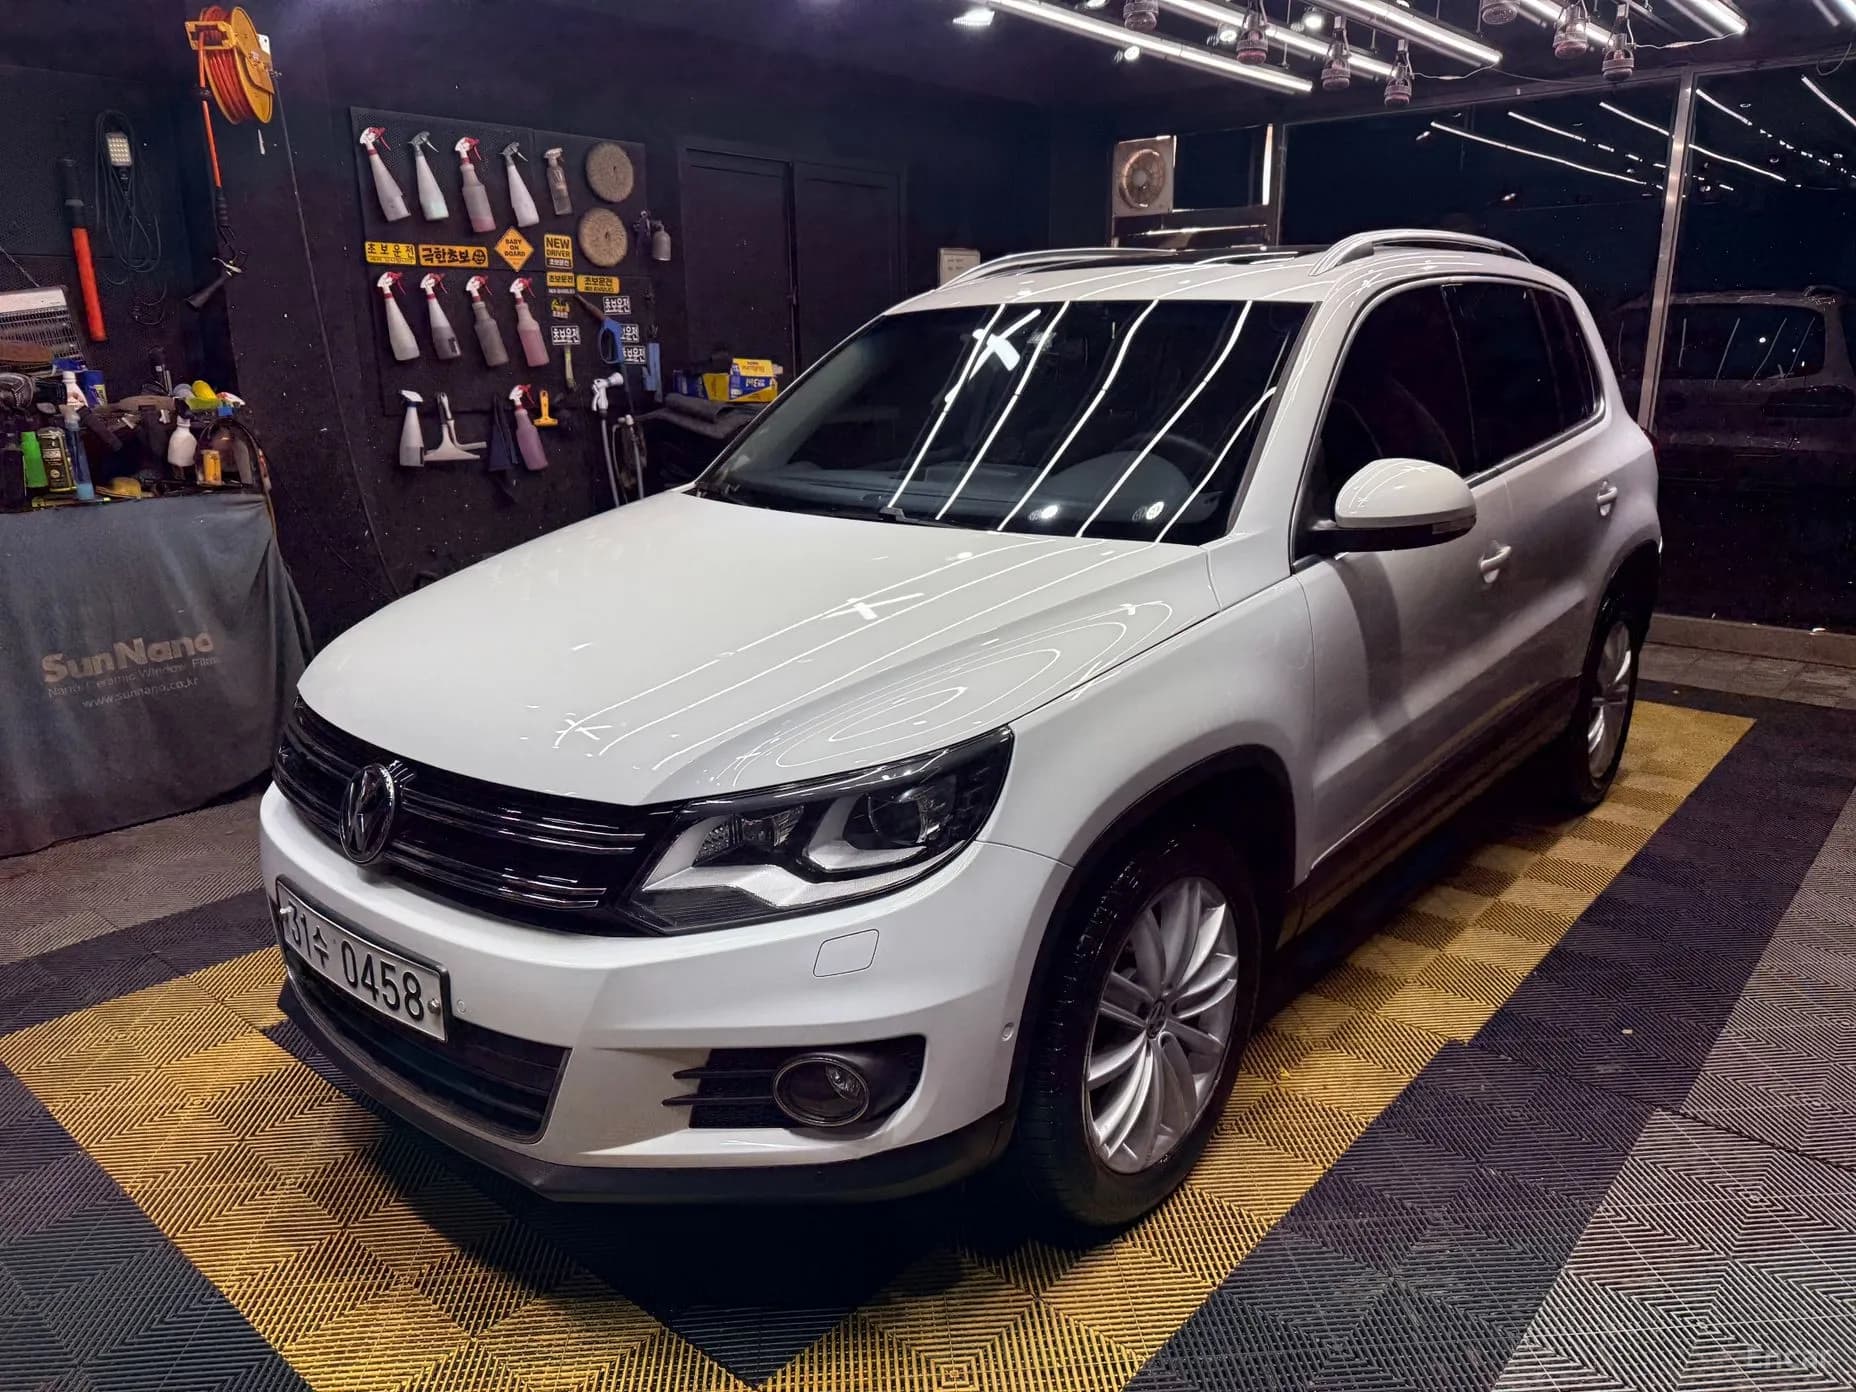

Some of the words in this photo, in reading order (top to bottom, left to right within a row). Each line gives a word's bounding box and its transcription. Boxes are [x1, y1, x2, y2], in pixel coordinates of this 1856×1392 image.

[367, 243, 415, 258] 초보운전
[546, 237, 570, 249] NEW
[421, 247, 471, 264] 극한초보
[546, 249, 571, 257] DRIVER
[603, 298, 631, 313] 초보운전
[552, 328, 581, 343] 초보운전
[41, 632, 214, 682] SunNano
[287, 898, 330, 968] 31수
[341, 940, 425, 1022] 0458
